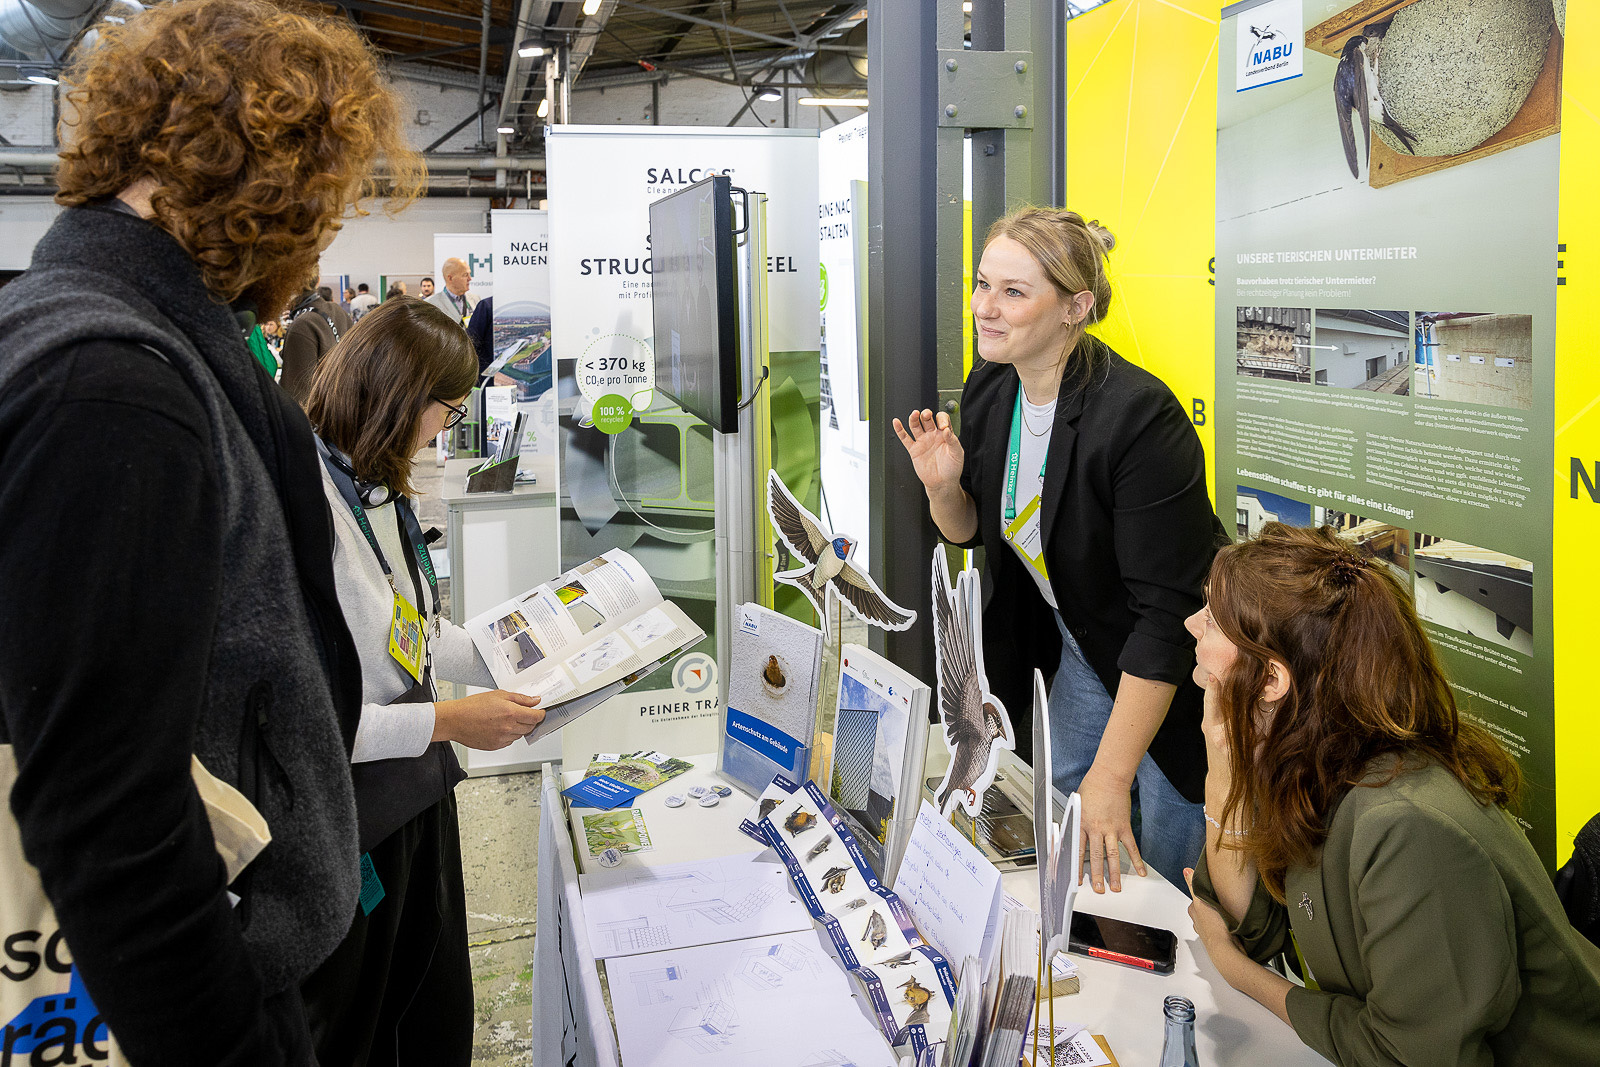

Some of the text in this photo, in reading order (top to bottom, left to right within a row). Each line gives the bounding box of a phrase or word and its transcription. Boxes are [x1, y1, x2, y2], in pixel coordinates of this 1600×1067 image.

[1253, 43, 1292, 65] NABU
[1276, 61, 1288, 69] Berlin
[510, 242, 548, 252] NACH
[504, 256, 547, 265] BAUEN
[1236, 246, 1417, 264] UNSERE TIERISCHEN UNTERMIETER
[622, 280, 638, 288] Eine
[1236, 276, 1376, 285] Bauvorhaben trotz tierischer Untermieter?
[1282, 289, 1304, 299] Planung
[1305, 289, 1318, 297] kein
[1319, 289, 1351, 298] Problem!
[599, 358, 627, 370] 370
[632, 360, 645, 372] kg
[608, 377, 620, 386] pro
[623, 375, 647, 384] Tonne
[600, 406, 624, 416] 100 %
[600, 416, 624, 424] recycled
[1008, 463, 1016, 493] Heinze
[1236, 467, 1413, 520] Lebensstätten schaffen: Es gibt für alles eine Lösung!
[417, 543, 434, 576] Heinze
[640, 702, 690, 716] PEINER
[732, 720, 788, 754] Artenschutz am Gebäude
[632, 809, 651, 851] RAUPENPOWER
